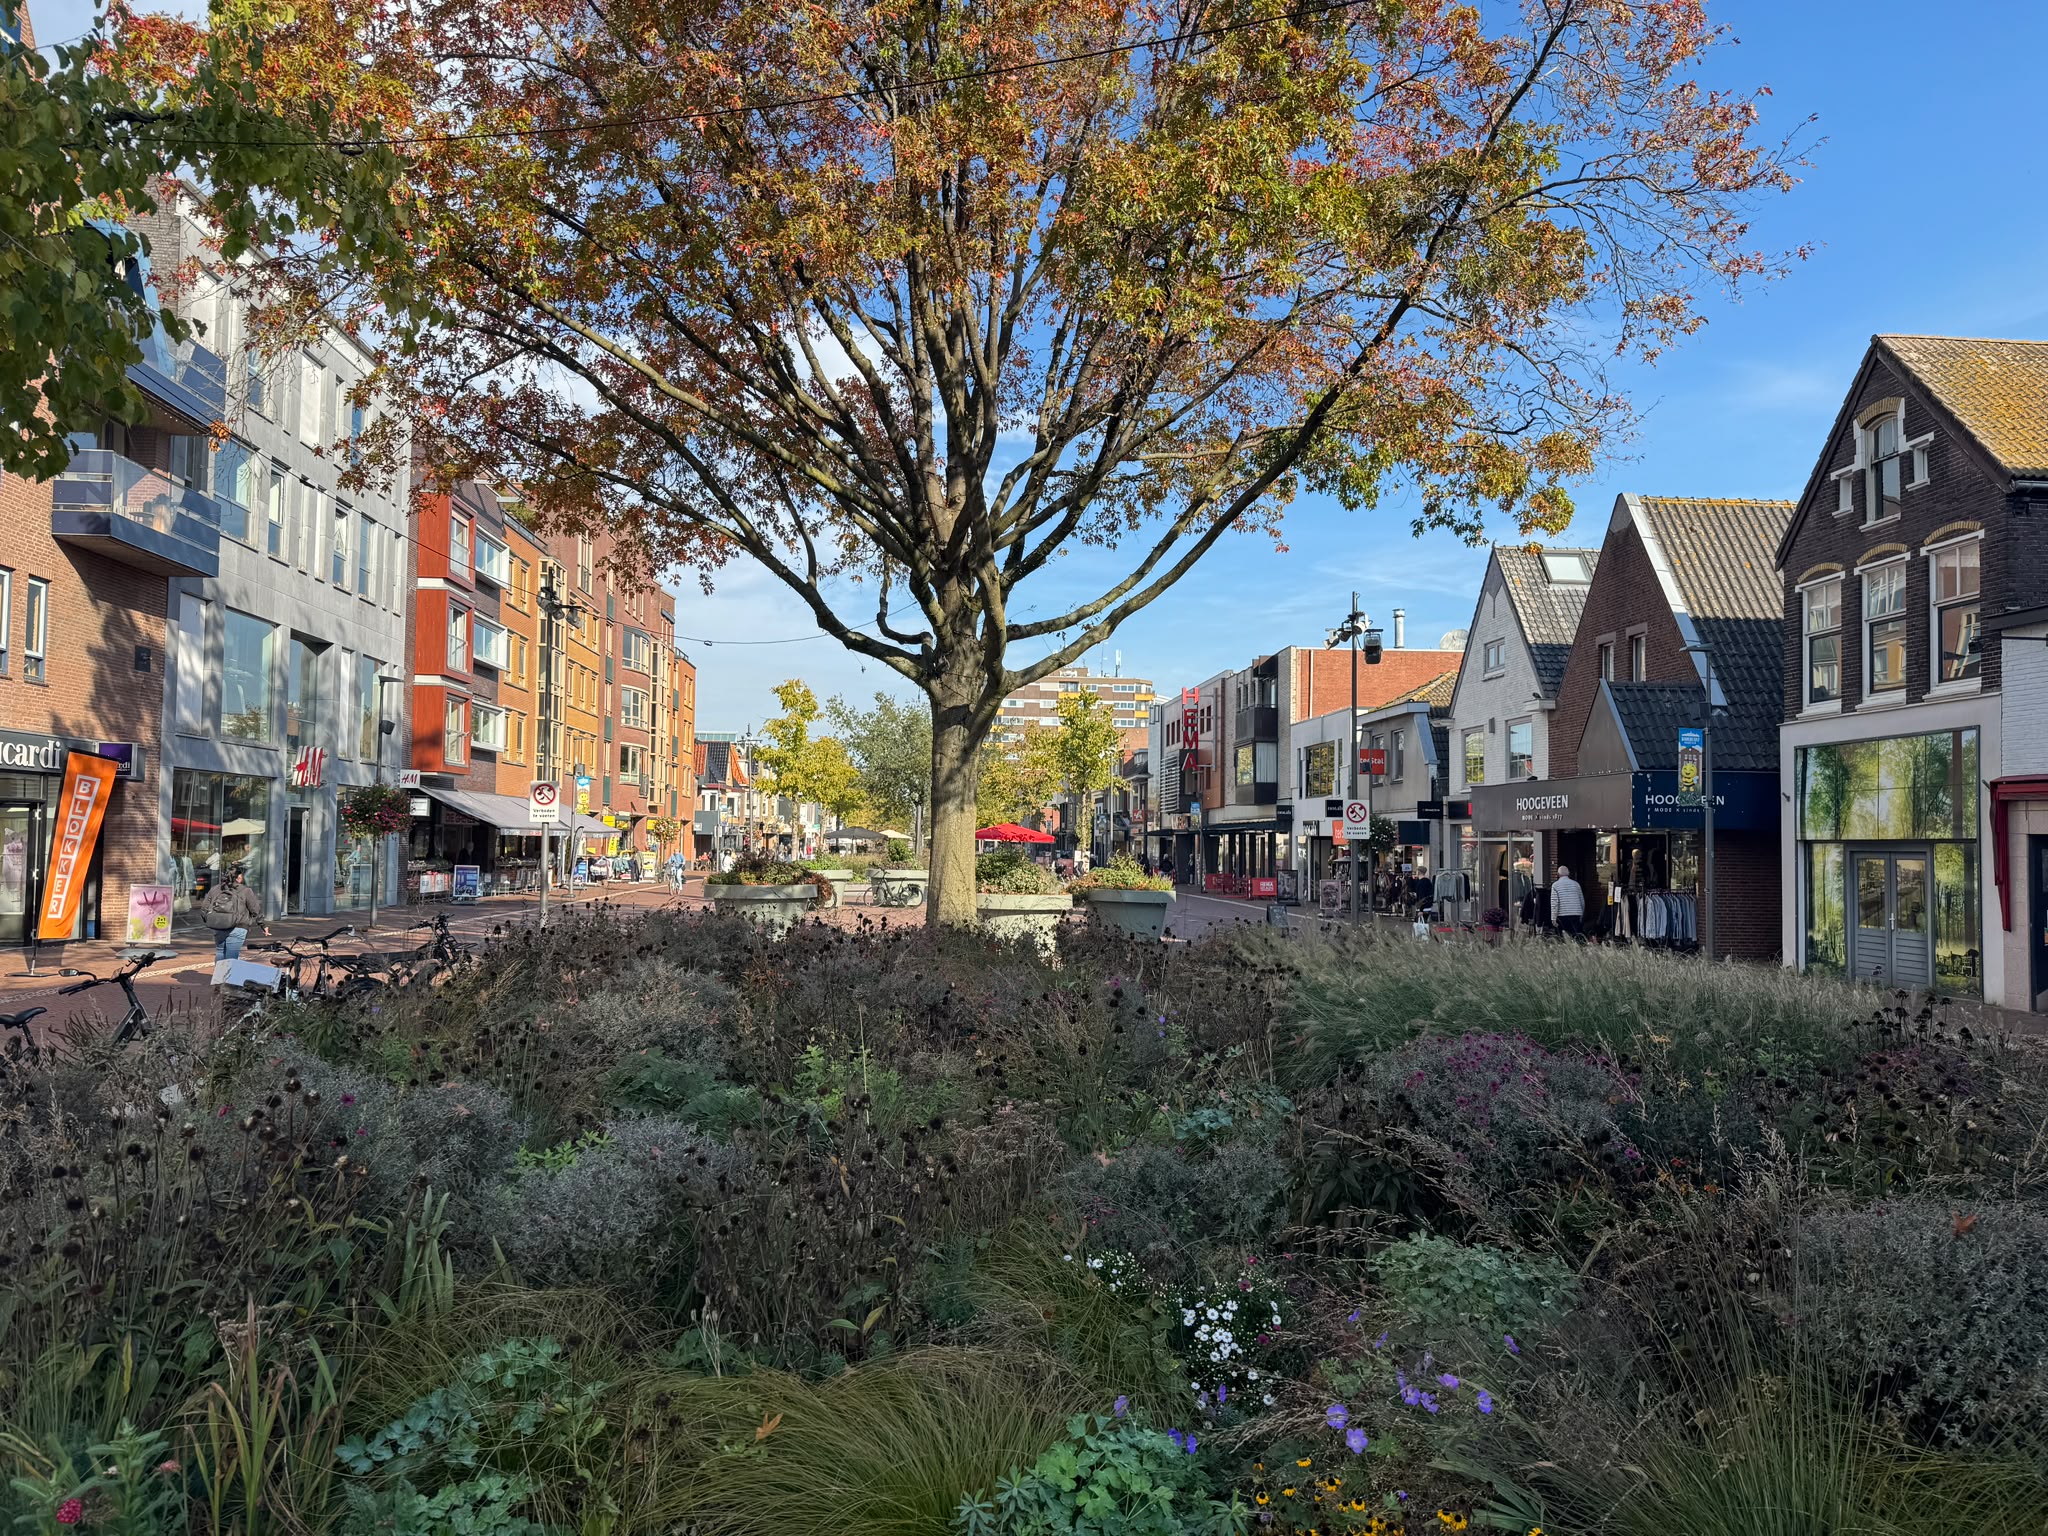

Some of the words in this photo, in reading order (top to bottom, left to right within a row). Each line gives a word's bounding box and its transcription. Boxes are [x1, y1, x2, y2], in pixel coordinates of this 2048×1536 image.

[1182, 687, 1199, 771] HEMA
[1516, 794, 1569, 811] HOOGEVEEN
[50, 780, 92, 912] BLOKKER
